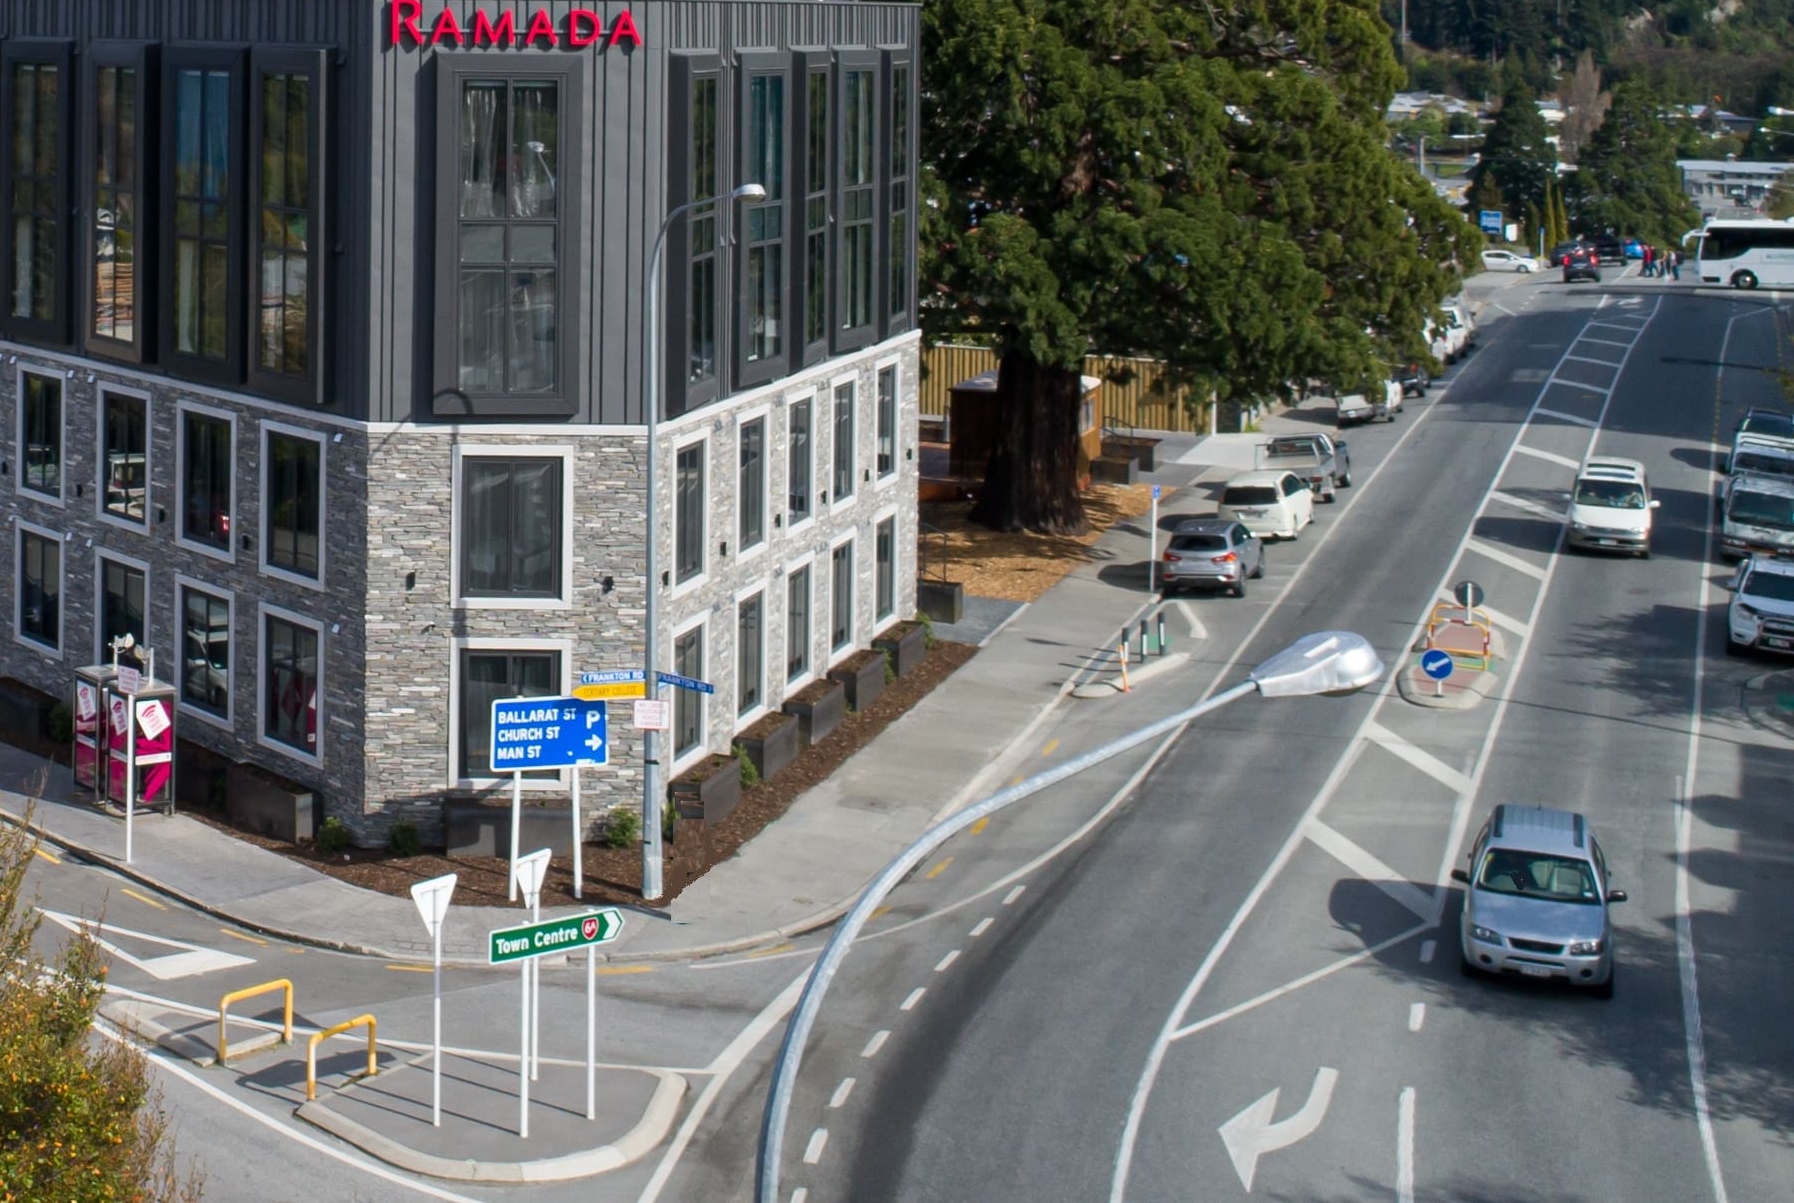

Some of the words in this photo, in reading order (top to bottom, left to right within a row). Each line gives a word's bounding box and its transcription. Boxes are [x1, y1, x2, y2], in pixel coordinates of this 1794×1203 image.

[588, 671, 631, 683] FRANKTON
[633, 670, 644, 679] RD
[612, 684, 637, 696] COLLEGE
[697, 682, 707, 691] RD
[498, 709, 559, 724] BALLARAT
[563, 708, 576, 720] ST
[498, 727, 543, 742] CHURCH
[546, 726, 560, 739] ST
[497, 746, 524, 760] MAN
[527, 745, 542, 758] ST
[585, 921, 596, 933] 6A
[496, 937, 529, 954] Town
[534, 927, 578, 947] Centre
